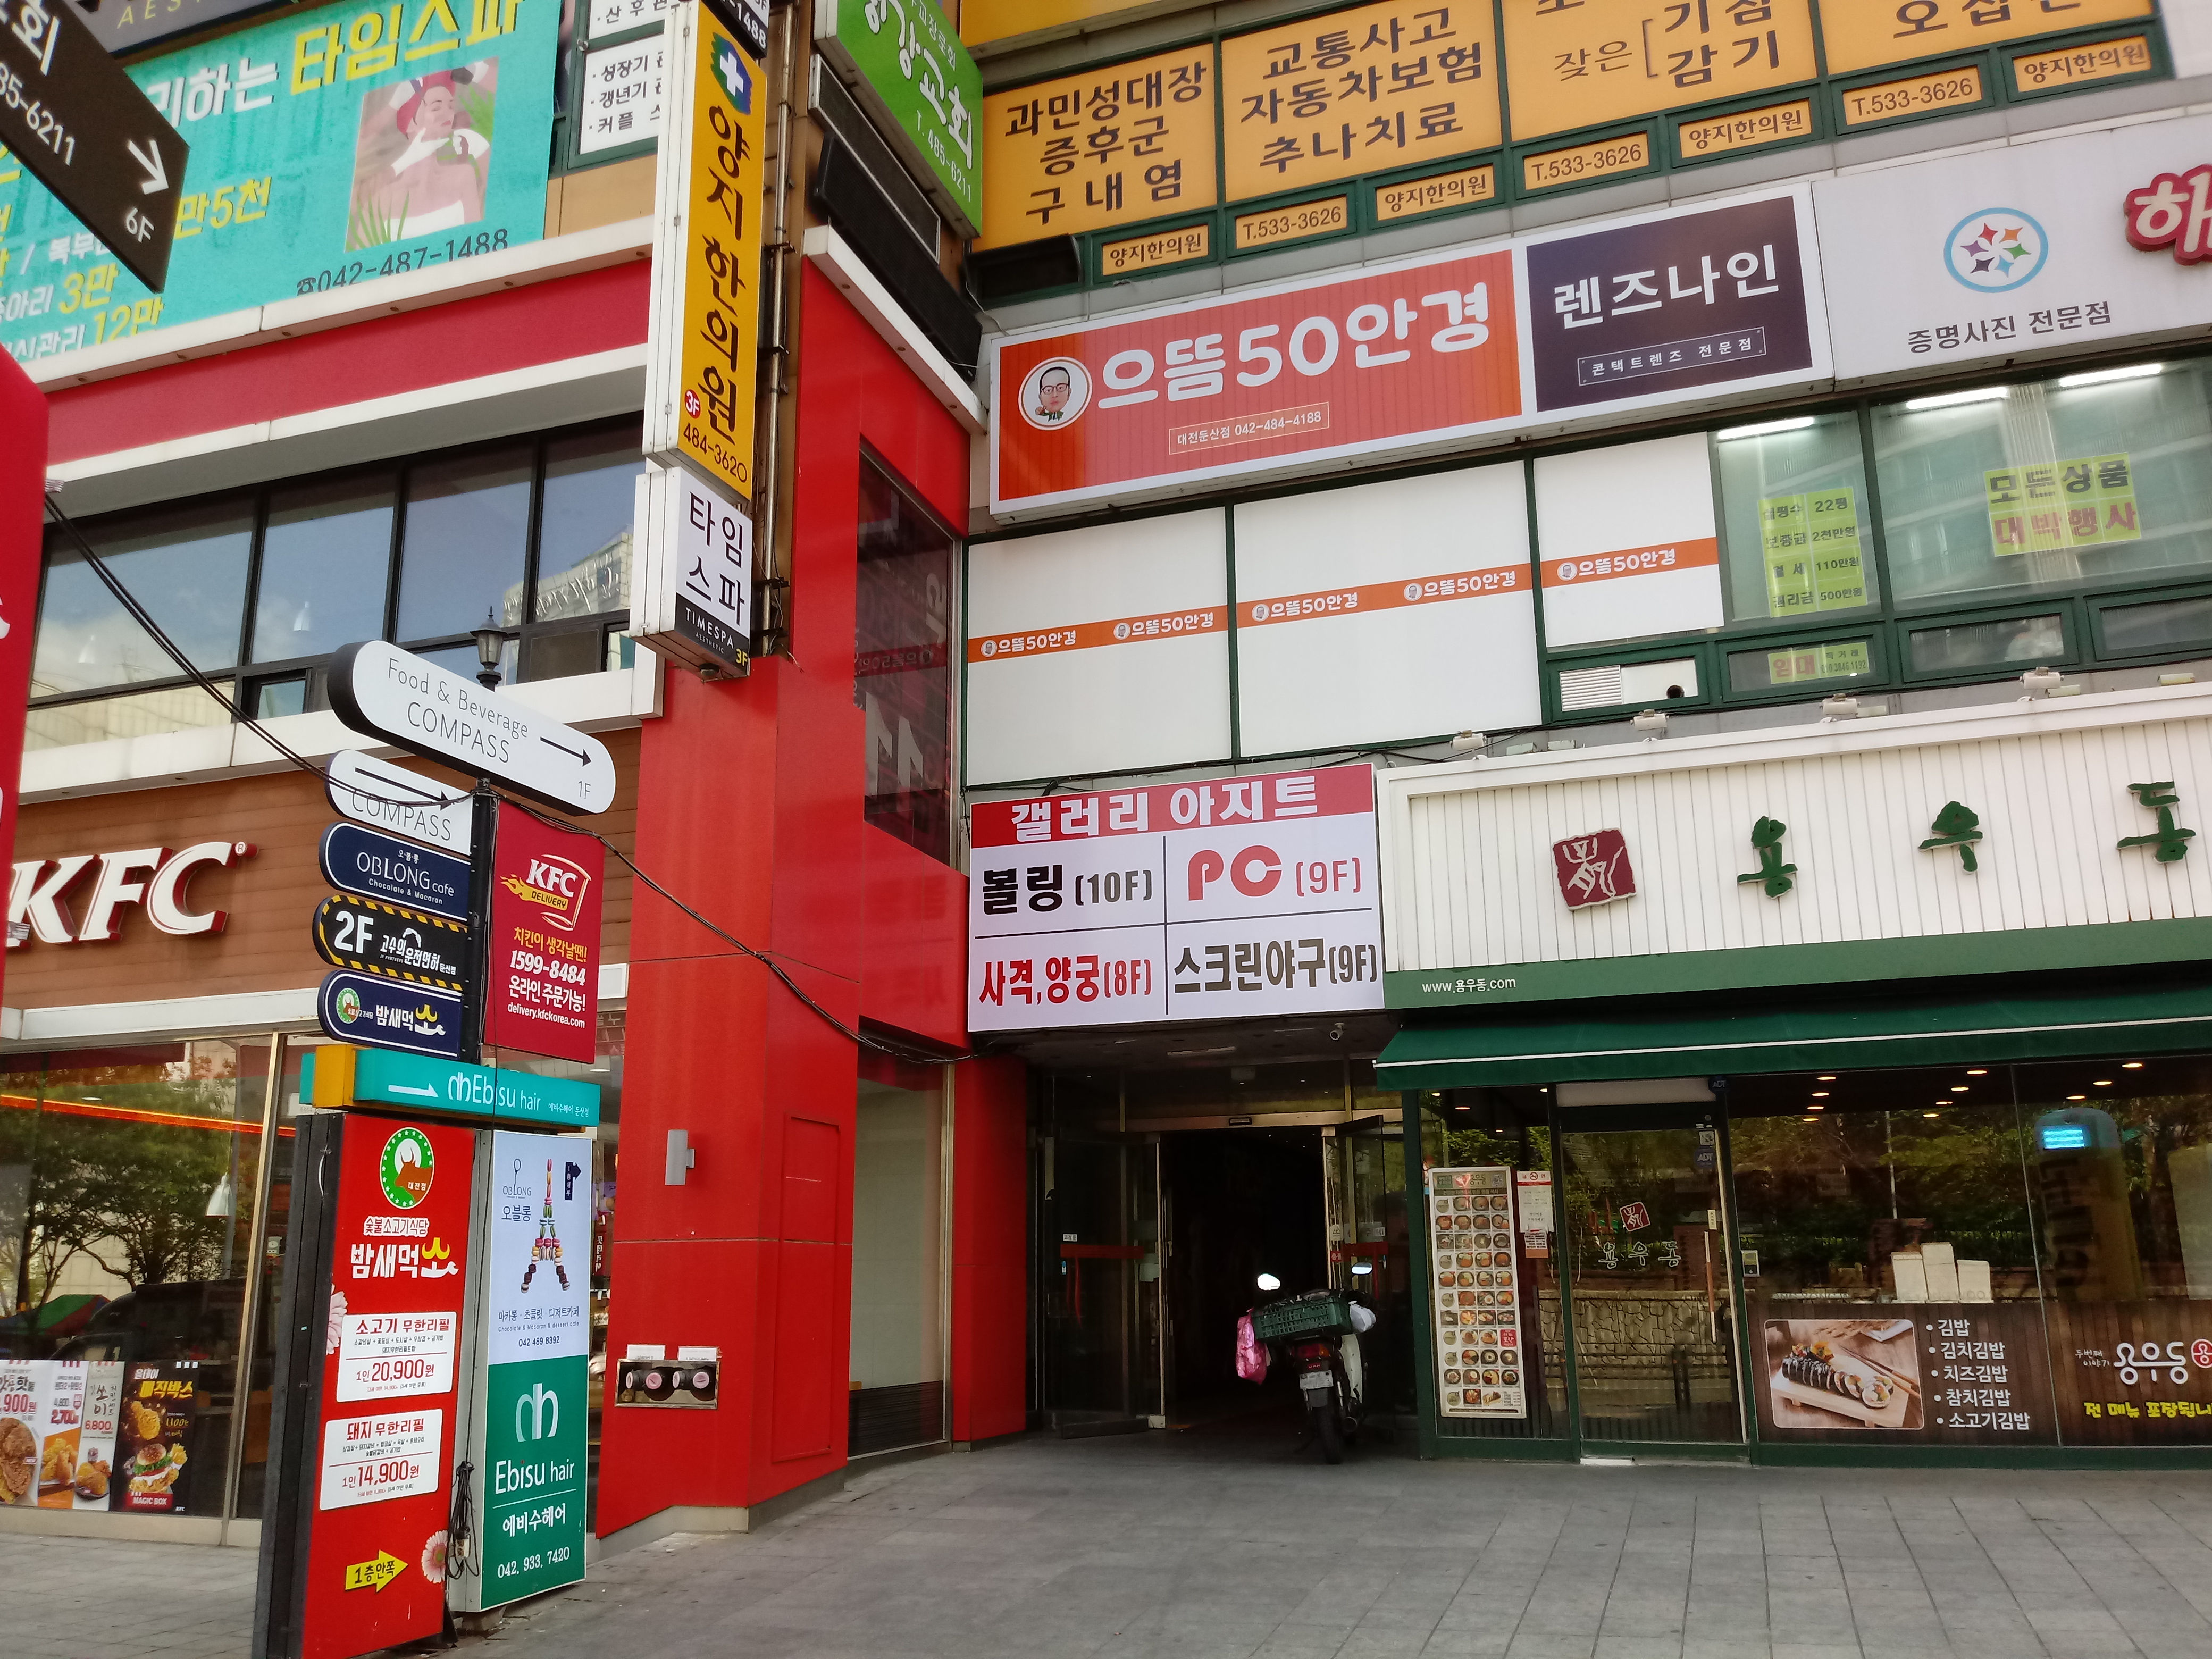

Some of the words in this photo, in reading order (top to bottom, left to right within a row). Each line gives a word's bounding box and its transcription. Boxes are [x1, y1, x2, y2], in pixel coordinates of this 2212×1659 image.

[291, 0, 525, 95] 타임스파
[1262, 7, 1456, 80] 교통사고
[1554, 40, 1632, 81] 잦은
[1668, 30, 1780, 88] 감기
[601, 52, 648, 82] 성장기
[2024, 43, 2148, 84] 양지한의원
[599, 81, 647, 109] 갱년기
[1005, 61, 1207, 137] 과민성대장
[1241, 42, 1482, 124] 자동차보험
[1852, 78, 1973, 116] T.533-3626
[598, 112, 633, 134] 커플
[1260, 102, 1463, 173] 추나치료
[1689, 110, 1803, 149] 양지한의원
[1040, 115, 1170, 175] 증후군
[1531, 143, 1642, 181] T.533-3626
[927, 129, 971, 202] 485-6211
[1385, 174, 1487, 213] 양지한의원
[126, 207, 155, 243] 6F
[1243, 206, 1342, 240] T.533-3626
[317, 228, 508, 294] 042-487-1488
[1110, 233, 1202, 267] 양지한의원
[59, 263, 120, 314] 3만
[698, 105, 751, 446] 양지한의원
[1554, 244, 1780, 330] 렌즈나인
[1908, 324, 2016, 354] 증명사진
[2027, 301, 2112, 334] 전문점
[1098, 281, 1490, 409] 으뜸50안경
[1591, 350, 1682, 377] 콘택트렌즈
[1698, 337, 1753, 358] 전문점
[686, 390, 700, 417] 3F
[1177, 425, 1231, 447] 대전둔산점
[1235, 410, 1322, 438] 042-484-4188
[683, 423, 748, 483] 484-3620
[1815, 497, 1849, 513] 22평
[690, 491, 744, 569] 타임
[1812, 525, 1856, 541] 2천만원
[1578, 548, 1676, 577] 으뜸50안경
[1816, 556, 1859, 571] 110만원
[686, 555, 745, 626] 스파
[1423, 571, 1516, 597] 으뜸50안경
[1821, 587, 1863, 601] 500만원
[1270, 592, 1358, 617] 으뜸50안경
[684, 607, 734, 649] TIMESPA
[1131, 612, 1214, 636] 으뜸50안경
[736, 647, 749, 667] 3F
[998, 631, 1076, 653] 으뜸50안경
[388, 658, 428, 694] Food
[437, 681, 450, 704] &
[459, 689, 528, 740] Beverage
[407, 701, 509, 763] COMPASS
[578, 781, 591, 799] 1F
[351, 789, 451, 841] COMPASS
[1011, 791, 1149, 842] 갤러리
[1170, 775, 1318, 825] 아지트
[357, 852, 430, 890] OBLONG
[432, 882, 454, 896] cafe
[526, 859, 577, 898] KFC
[983, 864, 1063, 915] 볼링
[1187, 845, 1283, 901] PC
[5, 842, 232, 948] KFC
[368, 878, 404, 895] Chocolate
[414, 891, 442, 905] Macaron
[531, 890, 566, 909] DELIVERY
[334, 911, 374, 955] 2F
[380, 935, 407, 956] 고수의
[514, 926, 544, 952] 치킨이
[546, 937, 588, 963] 생각날땐!
[404, 948, 441, 971] 운전면허
[509, 950, 586, 986] 1599-8484
[508, 975, 541, 1003] 온라인
[542, 983, 585, 1012] 주문가능!
[1422, 976, 1516, 993] www.용우동.com
[507, 1001, 585, 1029] delivery.kfckorea.com
[473, 1074, 516, 1108] Ebisu
[520, 1094, 541, 1111] hair
[574, 1106, 589, 1118] 둔산점
[1697, 1153, 1714, 1161] ADT
[408, 1182, 426, 1191] 대전점
[503, 1185, 532, 1196] OBLONG
[365, 1218, 428, 1235] 숯불소고기식당
[501, 1205, 532, 1222] 오블롱
[1598, 1241, 1682, 1269] 용우동
[356, 1319, 397, 1335] 소고기
[403, 1318, 450, 1333] 무한리필
[498, 1310, 517, 1322] 마카롱
[524, 1308, 543, 1320] 초콜릿
[549, 1306, 579, 1318] 디저트카페
[1937, 1318, 1971, 1337] 김밥
[518, 1338, 530, 1347] 042
[532, 1337, 543, 1346] 489
[546, 1335, 560, 1345] 8392
[1940, 1342, 2006, 1360] 김치김밥
[2075, 1349, 2103, 1359] 두번째
[356, 1370, 370, 1382] 1인
[372, 1359, 434, 1381] 20,900원
[1943, 1365, 2009, 1384] 치즈김밥
[2083, 1359, 2110, 1368] 이야기
[2113, 1342, 2189, 1385] 용우동
[1946, 1388, 2012, 1407] 참치김밥
[2083, 1401, 2101, 1418] 전
[2107, 1401, 2140, 1418] 메뉴
[346, 1421, 372, 1440] 돼지
[375, 1418, 424, 1436] 무한리필
[1949, 1412, 2030, 1430] 소고기김밥
[342, 1476, 356, 1488] 1인
[358, 1460, 420, 1487] 14,900원
[495, 1459, 545, 1495] Ebisu
[550, 1458, 575, 1482] hair
[502, 1502, 566, 1538] 에비수헤어
[497, 1564, 519, 1579] 042.
[523, 1554, 543, 1572] 933.
[547, 1546, 571, 1565] 7420
